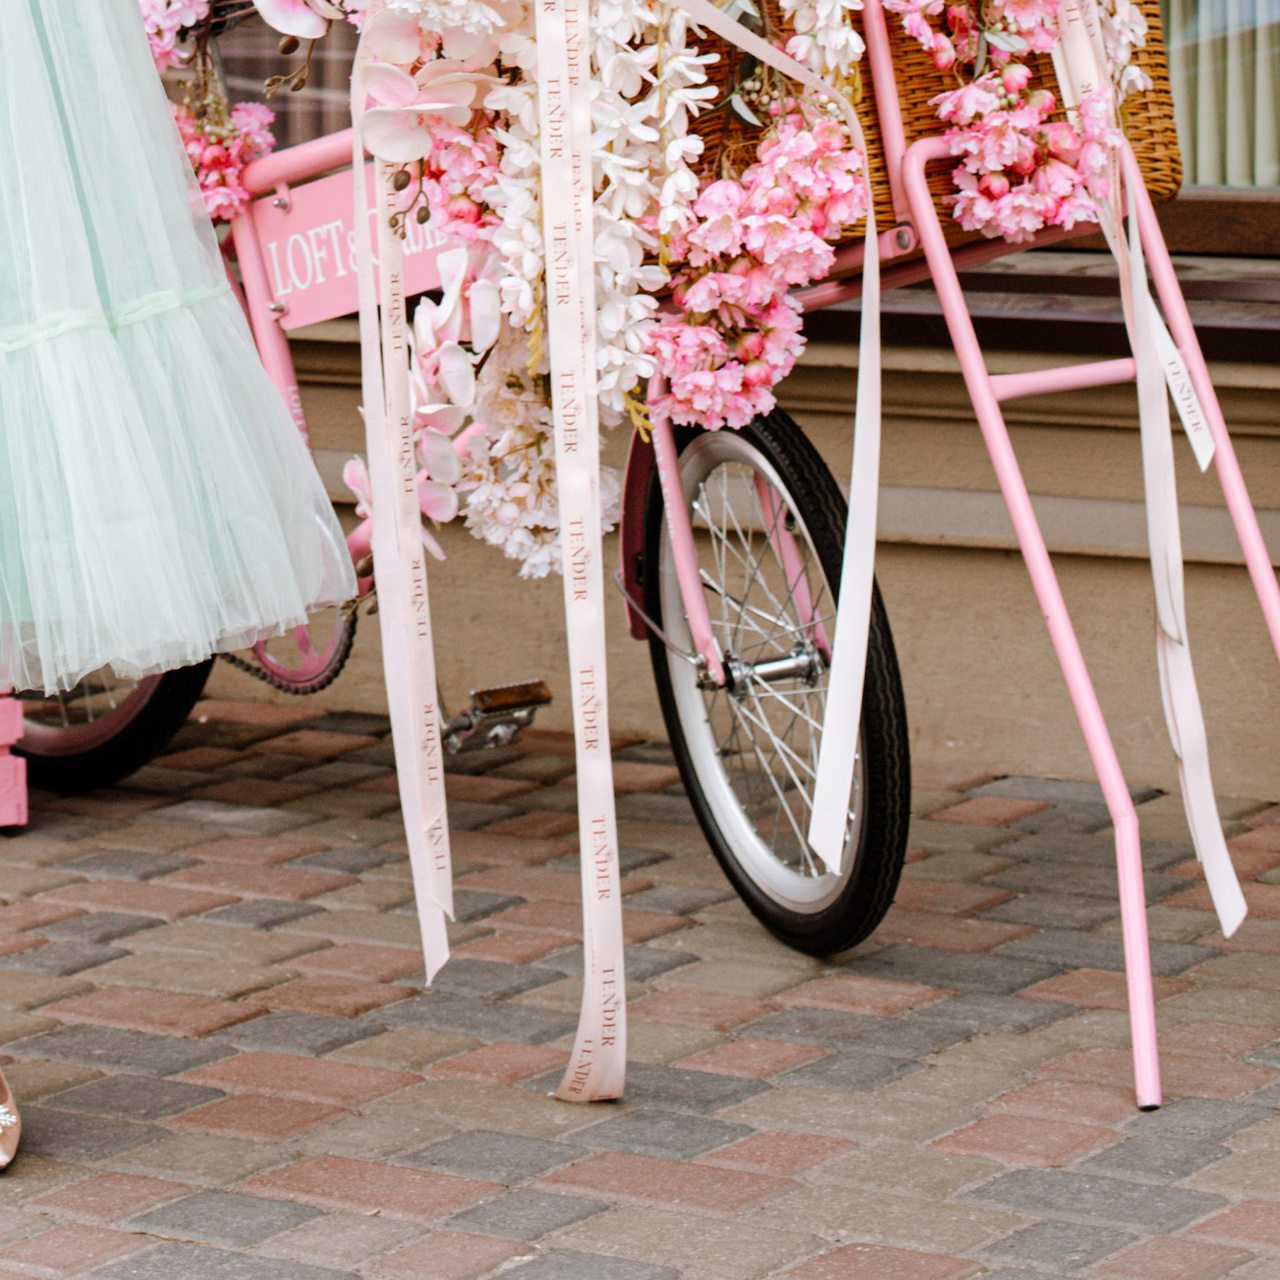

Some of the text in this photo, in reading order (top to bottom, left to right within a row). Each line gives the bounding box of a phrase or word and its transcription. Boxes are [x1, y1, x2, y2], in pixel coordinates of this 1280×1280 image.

[565, 5, 579, 86] TENDER
[547, 76, 563, 159] TENDER
[553, 222, 570, 306] TENDER
[391, 273, 403, 351] TENDER
[560, 369, 578, 454] TENDER
[1167, 358, 1204, 434] TENDER
[400, 416, 414, 497] TENDER
[412, 559, 427, 641] TENDER
[569, 517, 588, 602] TENDER
[423, 703, 439, 787] TENDER
[580, 665, 599, 751] TENDER
[591, 813, 611, 901] TENDER
[601, 965, 617, 1047] TENDER
[567, 1039, 593, 1095] TENDER
